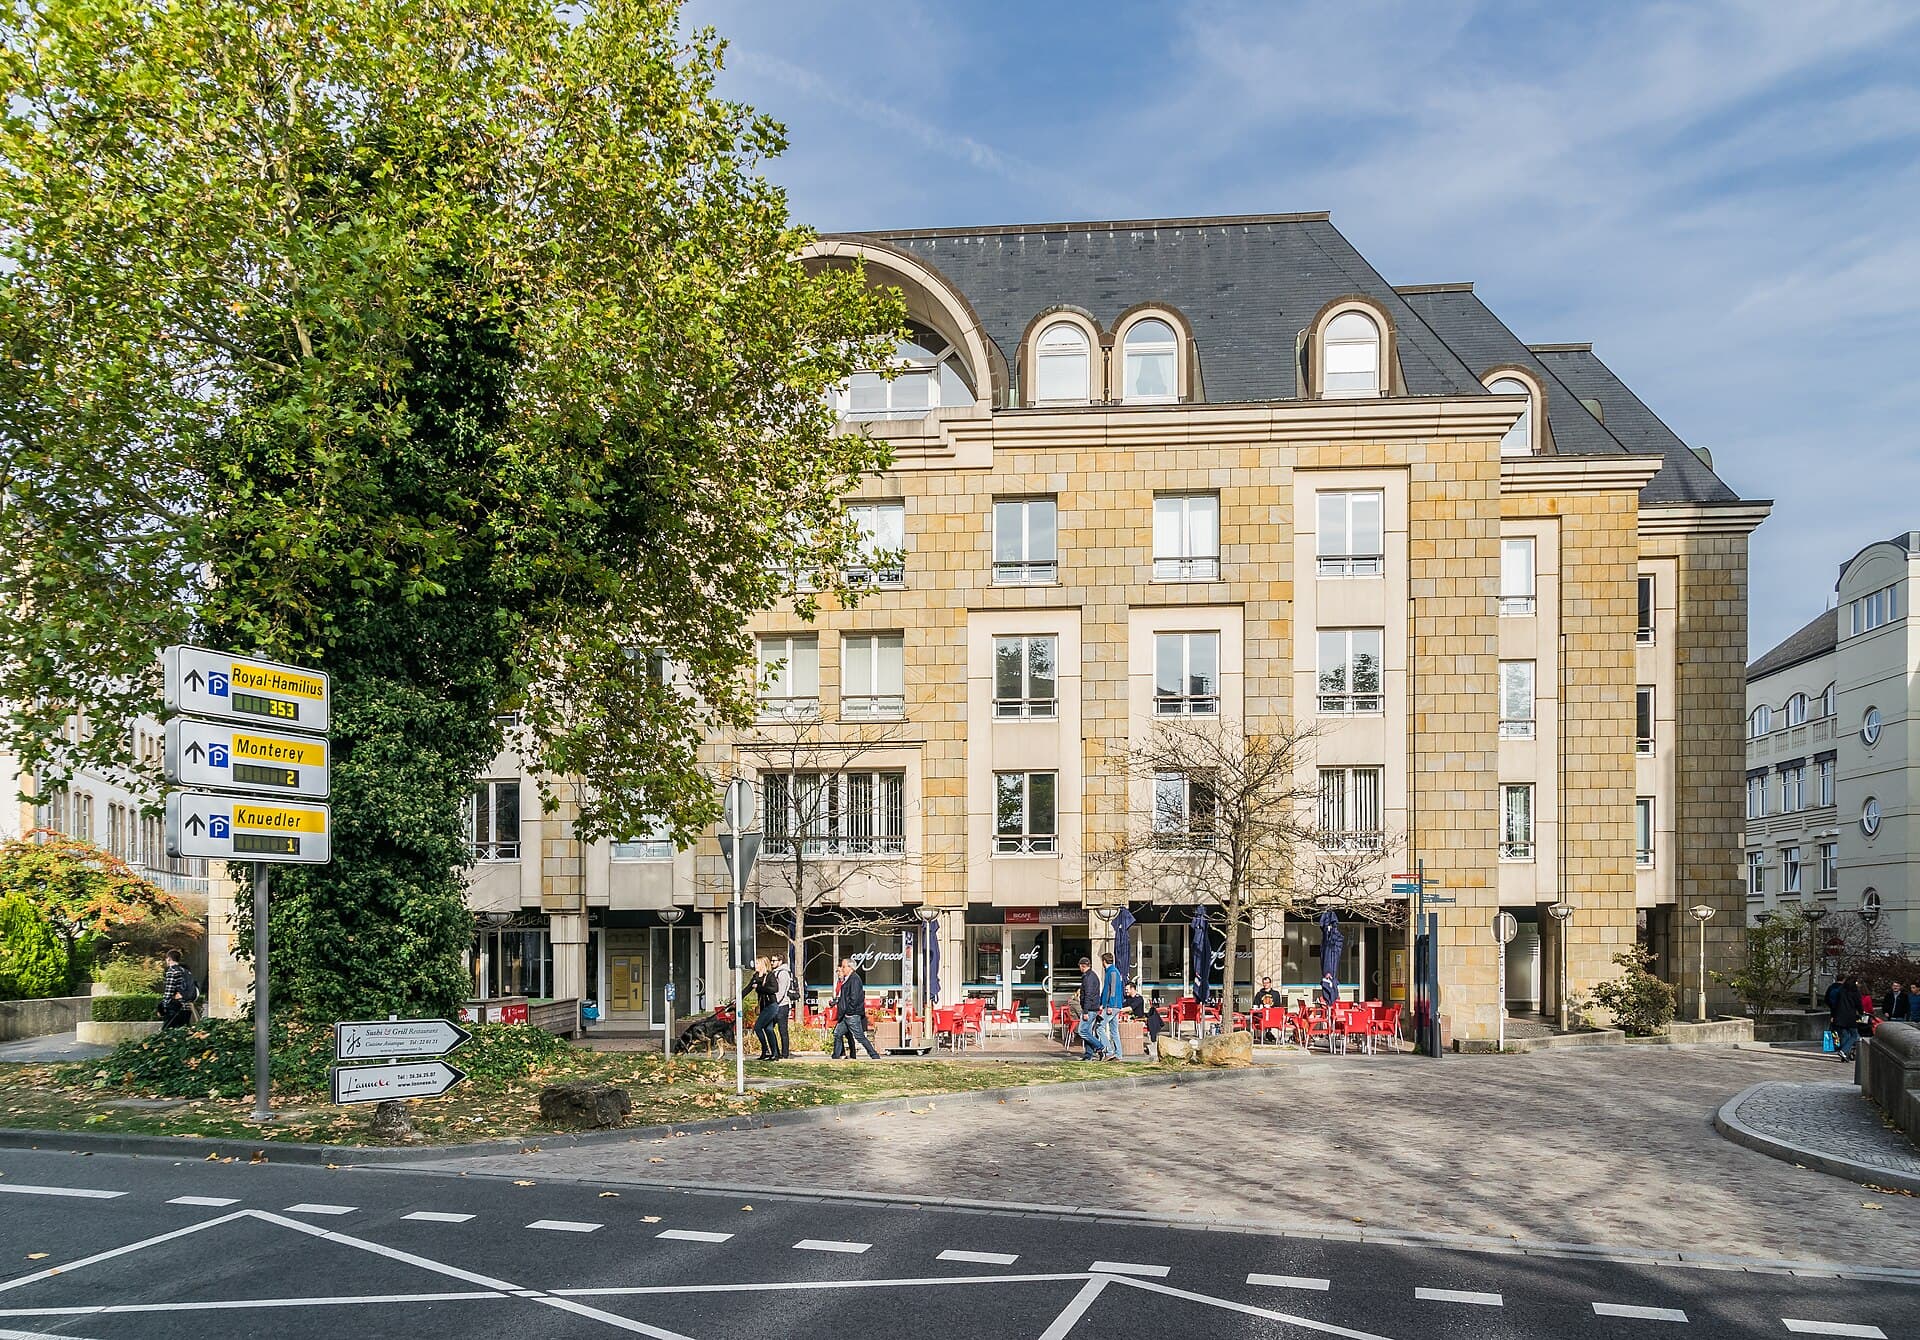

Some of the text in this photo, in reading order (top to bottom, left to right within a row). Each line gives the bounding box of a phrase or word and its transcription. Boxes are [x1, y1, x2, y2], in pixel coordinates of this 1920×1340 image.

[232, 667, 323, 697] Royal-Hamilius
[269, 699, 295, 718] 353
[236, 738, 304, 763] Monterey
[286, 771, 295, 785] 2
[237, 808, 301, 828] Knuedler
[287, 837, 295, 852] 1
[365, 1028, 383, 1037] Sushi
[392, 1027, 408, 1035] Grill
